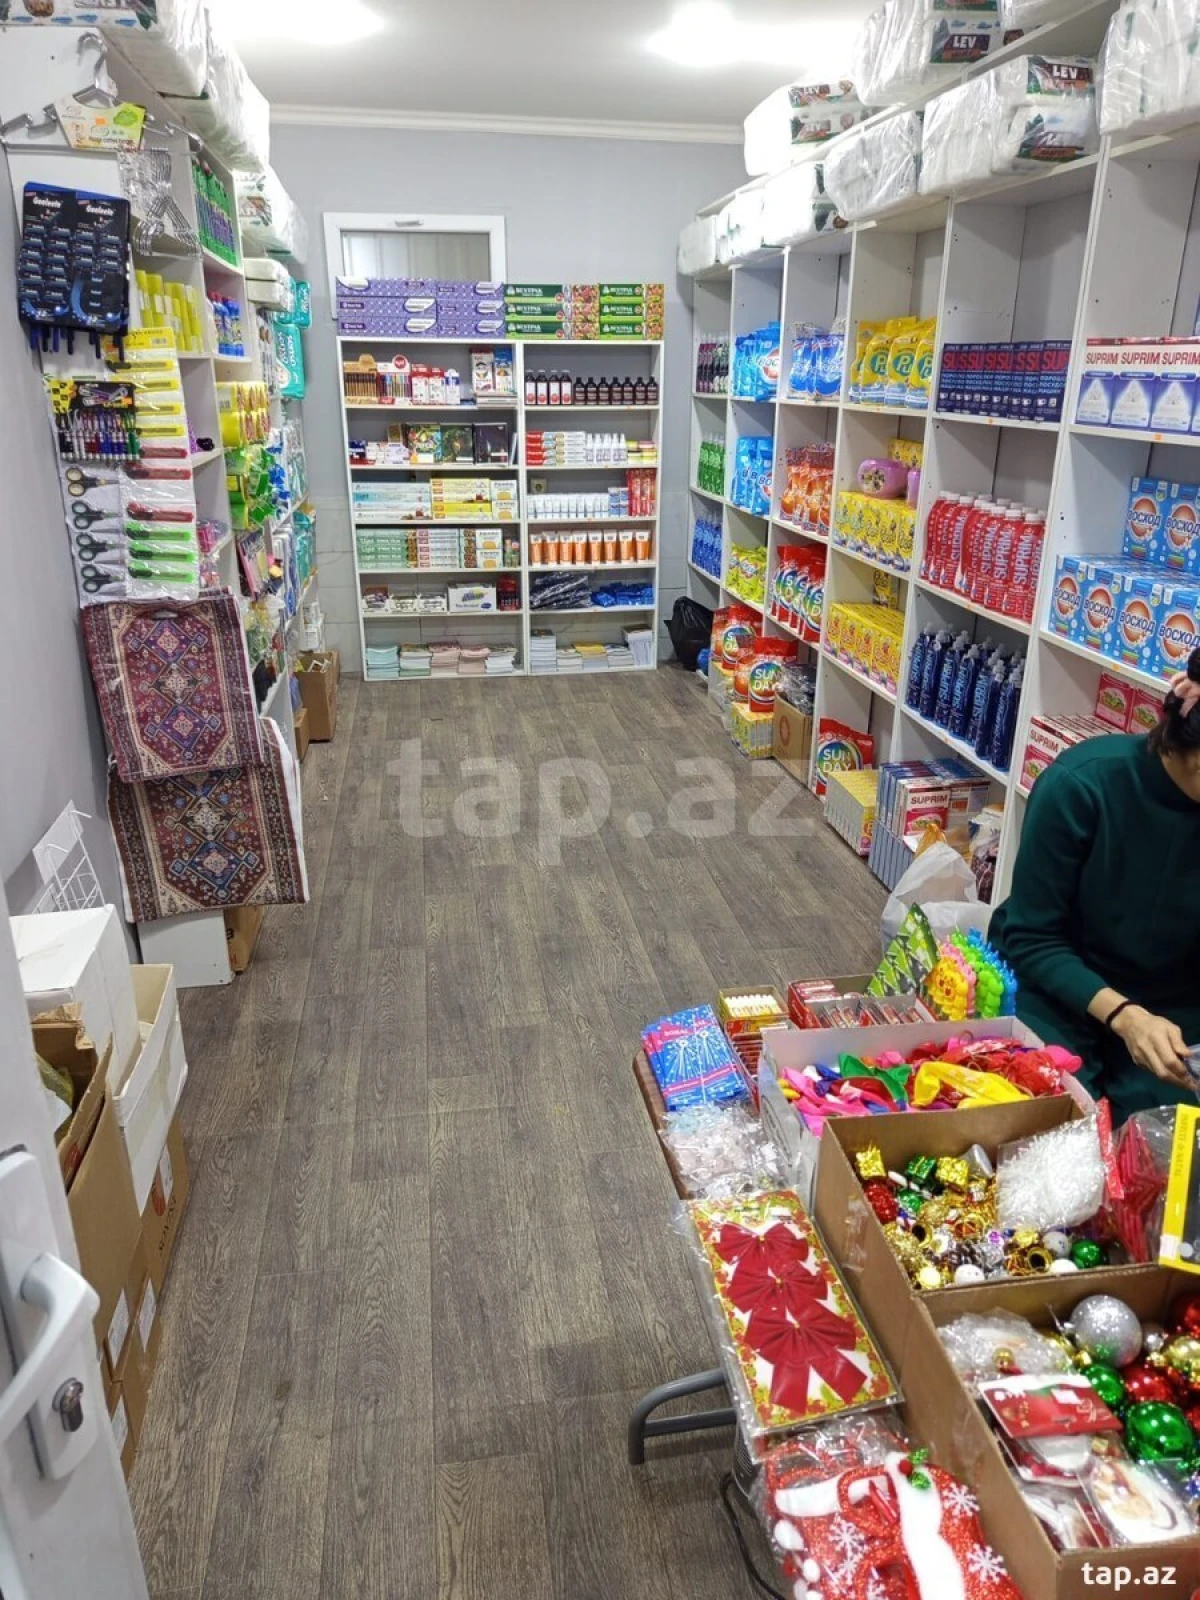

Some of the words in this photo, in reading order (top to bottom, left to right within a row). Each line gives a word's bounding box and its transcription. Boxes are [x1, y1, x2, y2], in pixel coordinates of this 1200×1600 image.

[952, 35, 977, 49] LEV
[1052, 65, 1078, 80] LEV
[1086, 352, 1119, 365] SUPRIM
[1121, 352, 1160, 365] SUPRIM
[1162, 352, 1200, 365] SUPRIM
[1127, 510, 1161, 527] ВОСХОД
[1166, 517, 1200, 535] ВОСХОД
[981, 526, 999, 573] SUPRIM
[993, 528, 1012, 579] SUPRIM
[1013, 534, 1034, 584] SUPRIM
[1054, 587, 1081, 608] ВОСХОД
[1083, 600, 1116, 621] ВОСХОД
[1119, 612, 1155, 635] ВОСХОД
[1159, 625, 1200, 649] ВОСХОД
[755, 669, 780, 680] SUN
[1030, 729, 1059, 752] SUPRIM
[823, 748, 850, 761] SUN
[823, 761, 851, 772] DAY
[911, 795, 948, 805] SUPRIM
